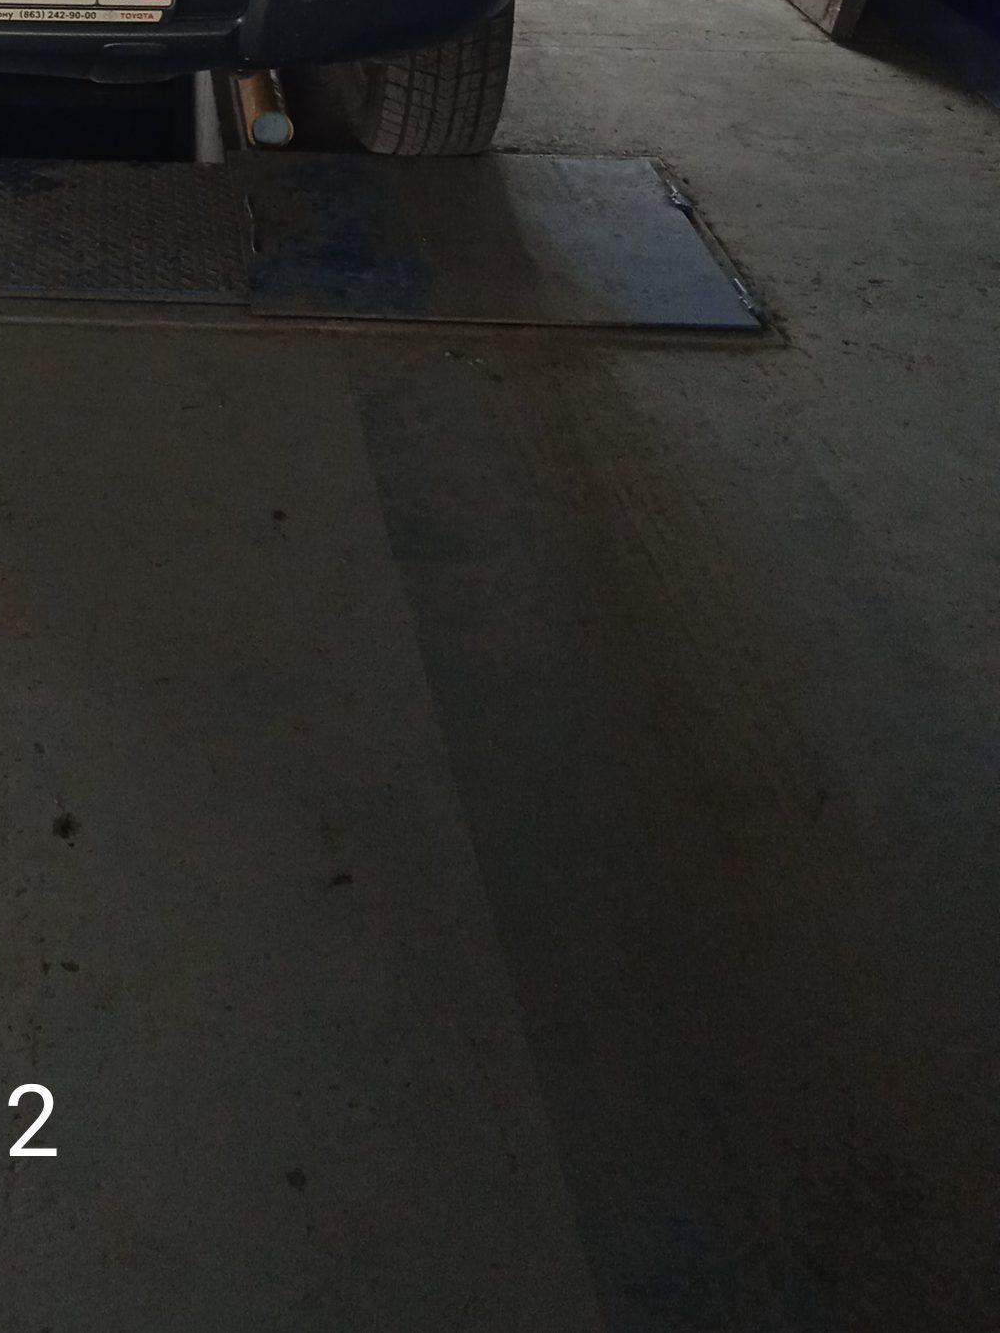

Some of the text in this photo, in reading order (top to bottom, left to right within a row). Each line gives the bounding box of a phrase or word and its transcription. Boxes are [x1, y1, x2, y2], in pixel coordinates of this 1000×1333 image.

[19, 10, 45, 19] (863)
[48, 11, 97, 20] 242-90-00
[120, 12, 154, 20] TOYOTA
